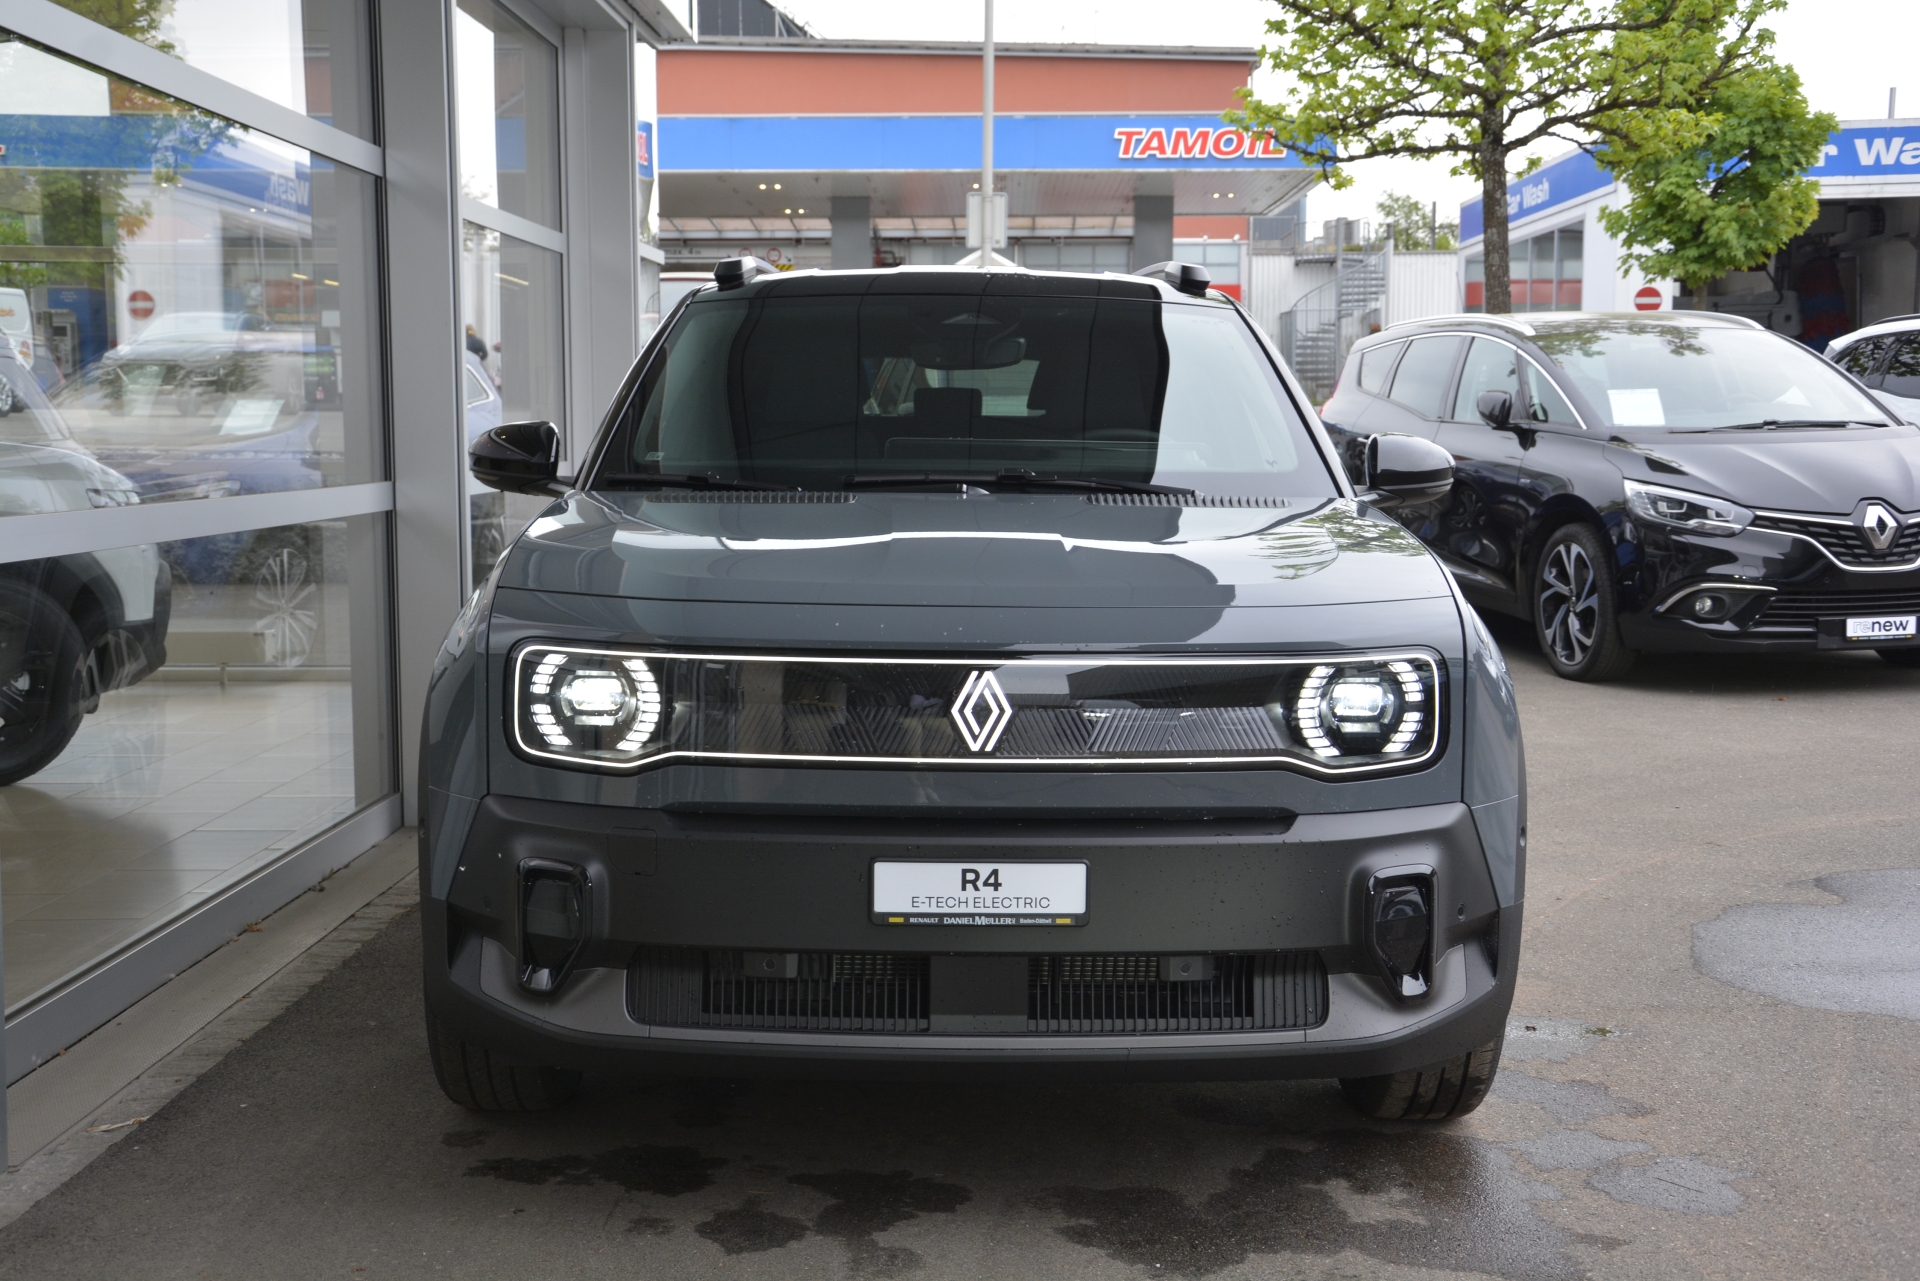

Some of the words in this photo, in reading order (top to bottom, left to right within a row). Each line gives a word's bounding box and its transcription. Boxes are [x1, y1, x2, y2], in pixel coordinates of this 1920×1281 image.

[1522, 177, 1549, 209] Wash
[1853, 620, 1909, 633] renew
[960, 868, 1003, 892] R4
[911, 896, 969, 908] E-TECH
[973, 896, 1051, 909] ELECTRIC
